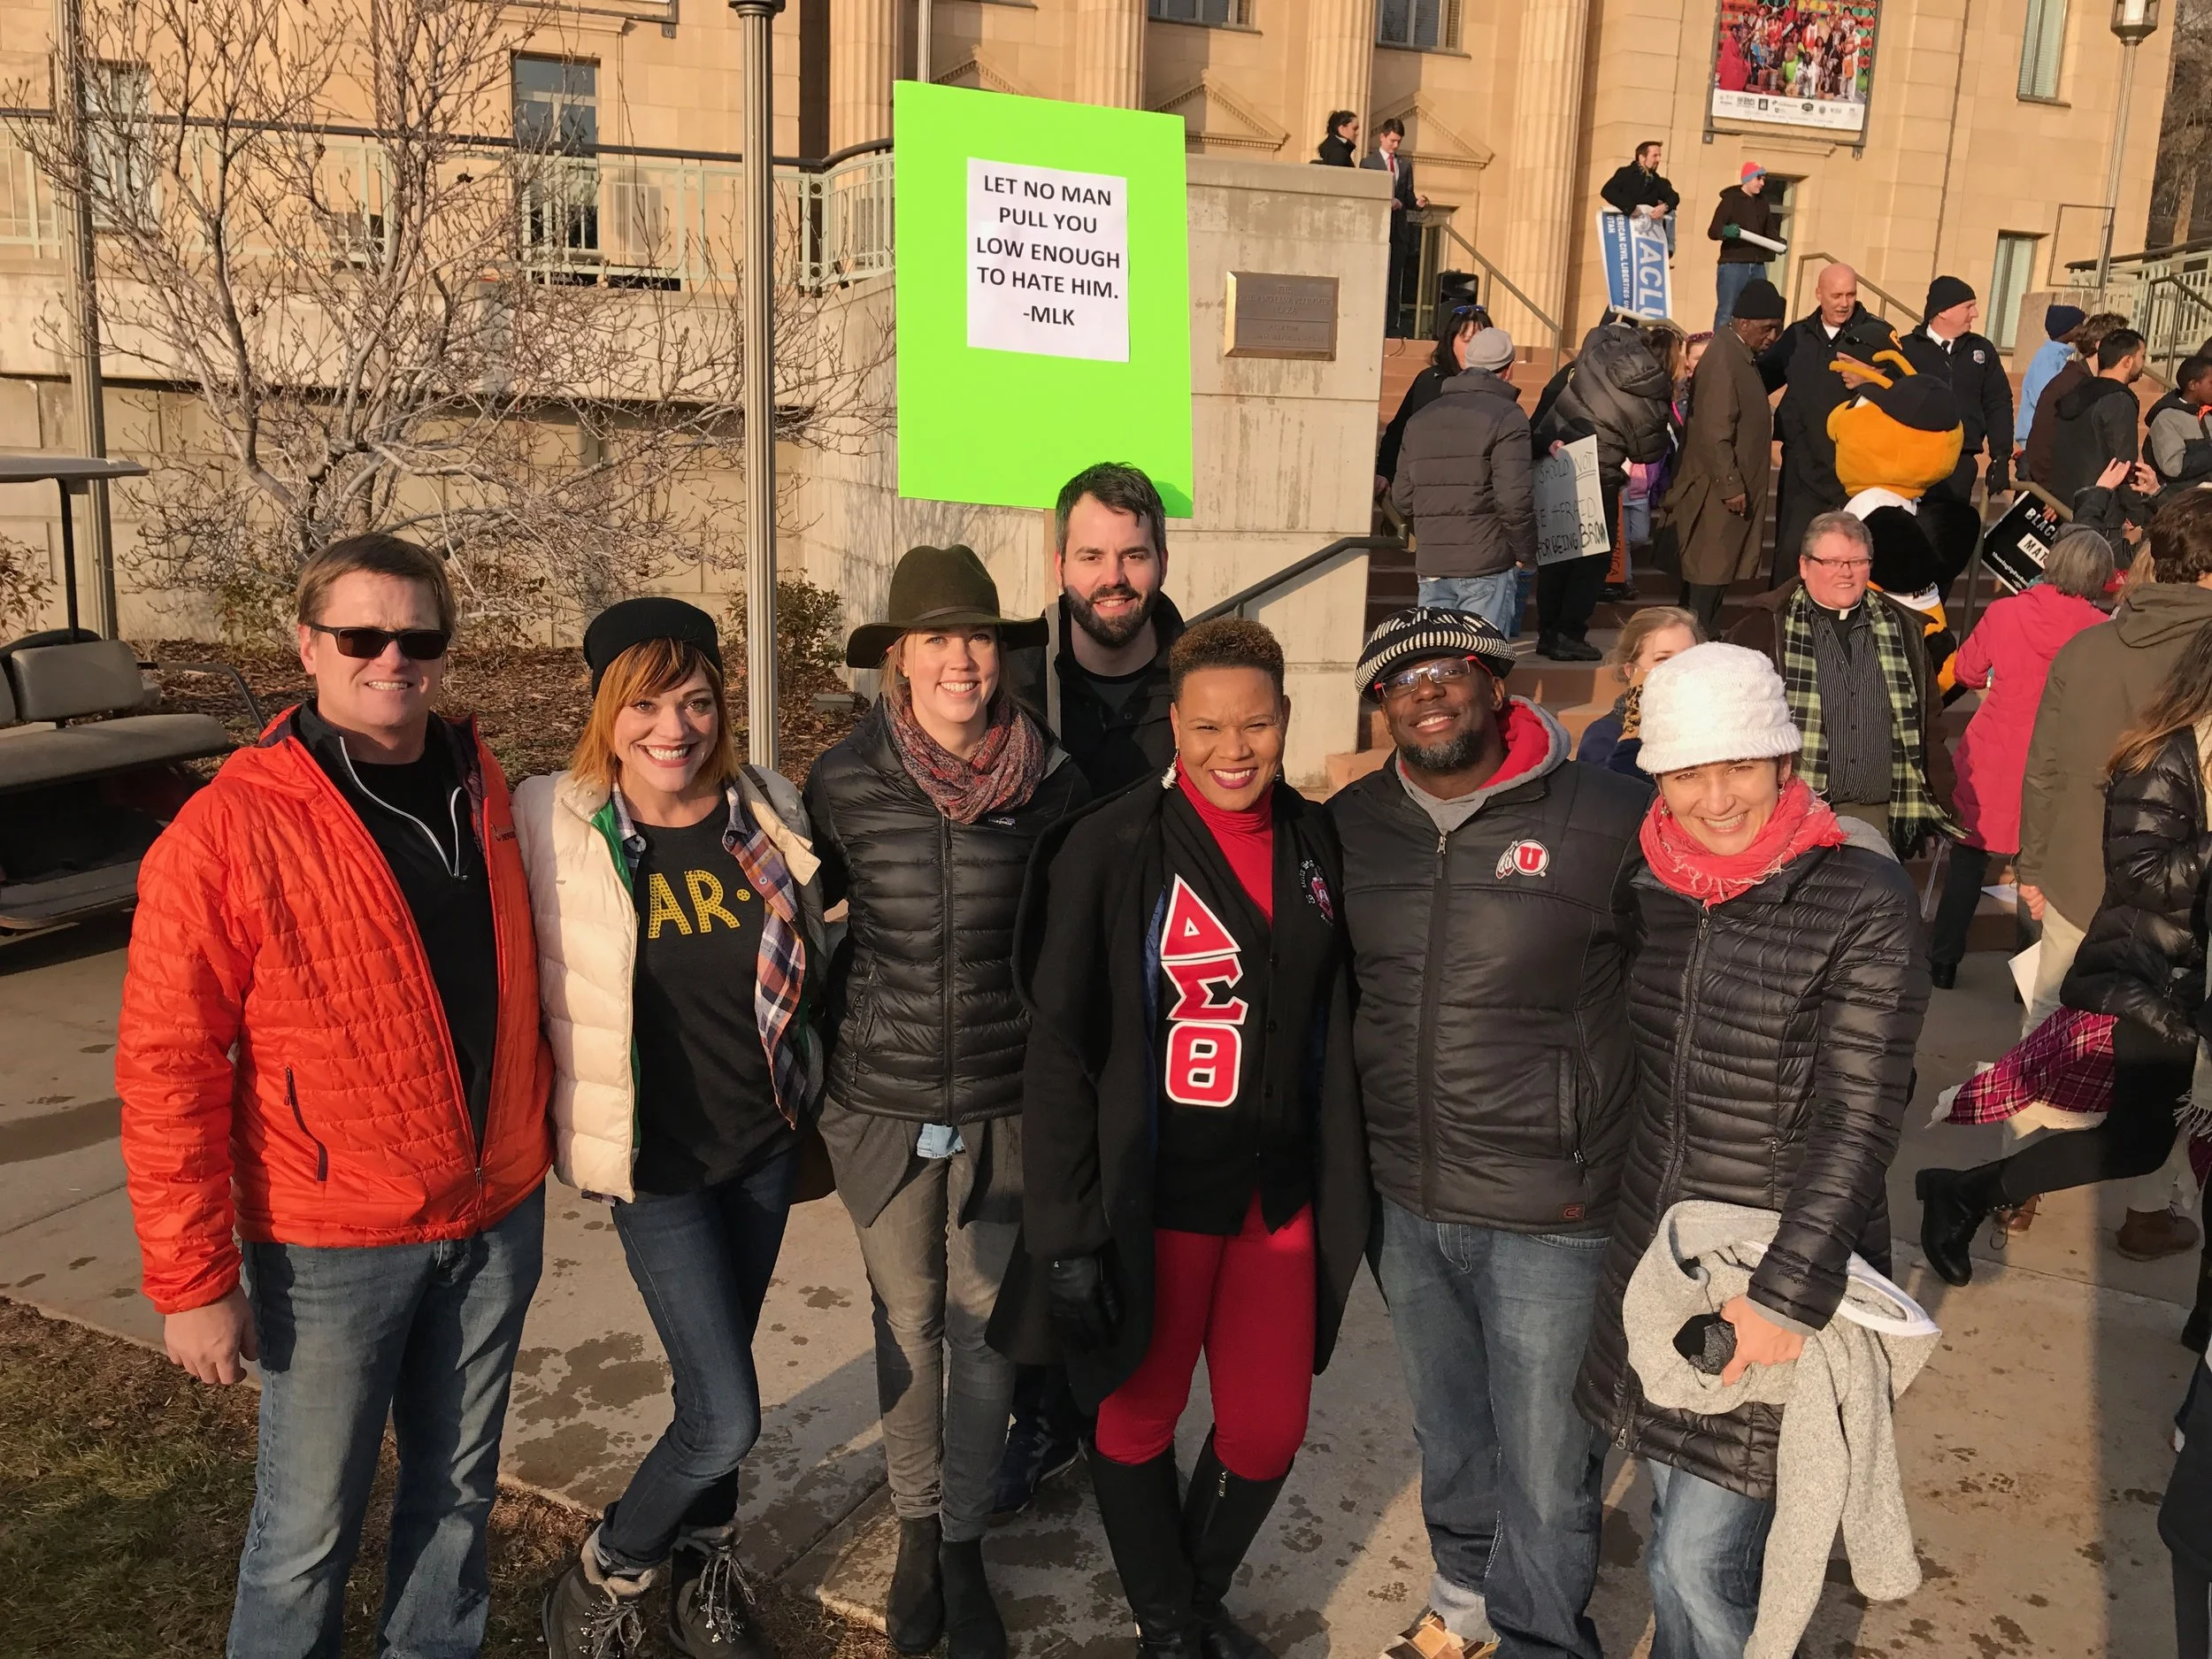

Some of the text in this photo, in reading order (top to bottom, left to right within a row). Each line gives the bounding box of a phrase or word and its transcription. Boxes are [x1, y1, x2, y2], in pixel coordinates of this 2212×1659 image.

[984, 175, 1111, 206] LET NO MAN
[999, 206, 1097, 234] PULL YOU
[1606, 215, 1616, 234] UTAH
[1617, 214, 1625, 243] ERICAN
[977, 236, 1120, 268] LOW ENOUGH
[1619, 243, 1628, 261] CIVIL
[977, 266, 1118, 299] TO HATE HIM.
[1621, 262, 1630, 299] LIBERTIES
[1640, 242, 1663, 319] ACLU
[1023, 305, 1075, 326] -MLK
[1575, 451, 1594, 472] NOT
[1519, 846, 1543, 871] U
[636, 870, 750, 939] AR.
